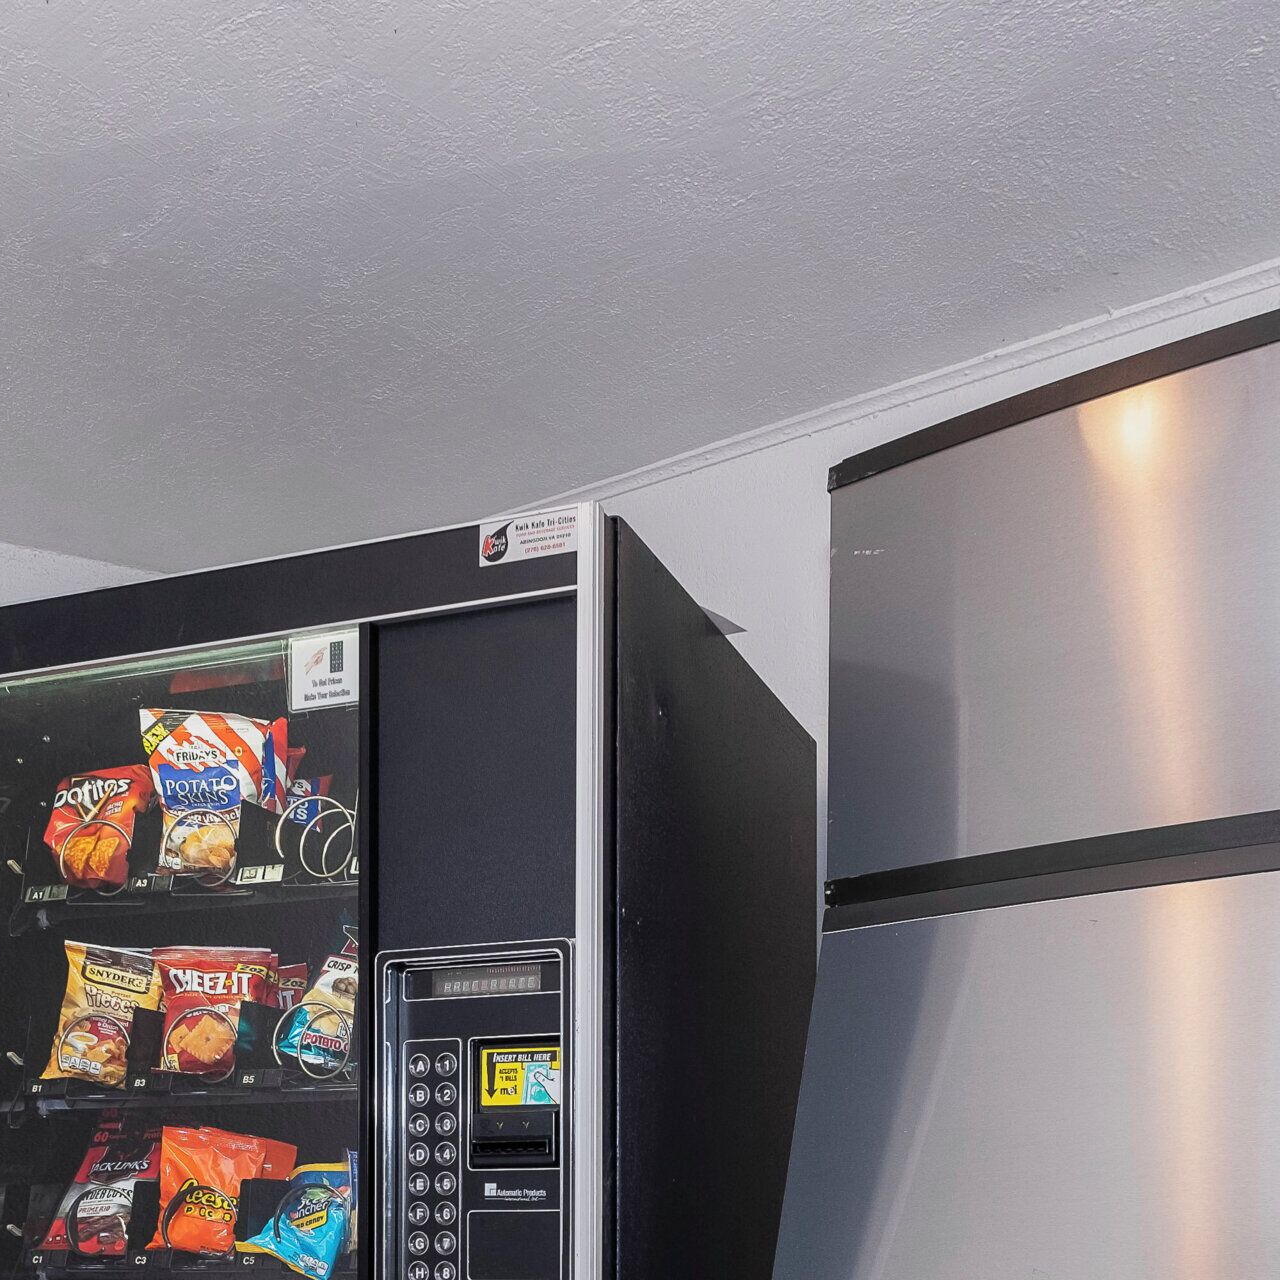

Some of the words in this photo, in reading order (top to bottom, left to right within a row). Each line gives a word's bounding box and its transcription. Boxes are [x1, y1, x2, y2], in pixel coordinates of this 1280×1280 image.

[515, 523, 529, 532] Kwik
[165, 775, 237, 796] POTATO
[54, 778, 131, 809] Doritos
[178, 790, 229, 807] SKINS
[244, 870, 256, 878] A5
[135, 879, 148, 888] A3
[32, 892, 43, 900] A1
[327, 959, 352, 972] CRISP
[303, 1034, 342, 1050] POTATO
[518, 1053, 532, 1062] BILL
[534, 1053, 552, 1062] HERE
[416, 1061, 425, 1071] A
[444, 1060, 450, 1070] 1
[242, 1076, 255, 1084] B5
[32, 1084, 42, 1092] B1
[416, 1090, 425, 1102] B
[444, 1090, 450, 1100] 2
[416, 1120, 424, 1130] C
[444, 1119, 450, 1130] 3
[416, 1149, 424, 1160] D
[444, 1148, 451, 1159] 4
[416, 1179, 424, 1190] E
[443, 1179, 450, 1190] 5
[416, 1209, 424, 1220] F
[443, 1208, 450, 1220] 6
[416, 1238, 424, 1250] G
[442, 1238, 450, 1249] 7
[32, 1256, 43, 1264] C1
[135, 1256, 146, 1264] C3
[242, 1256, 255, 1264] C5
[416, 1268, 424, 1279] H
[442, 1268, 450, 1279] 8
